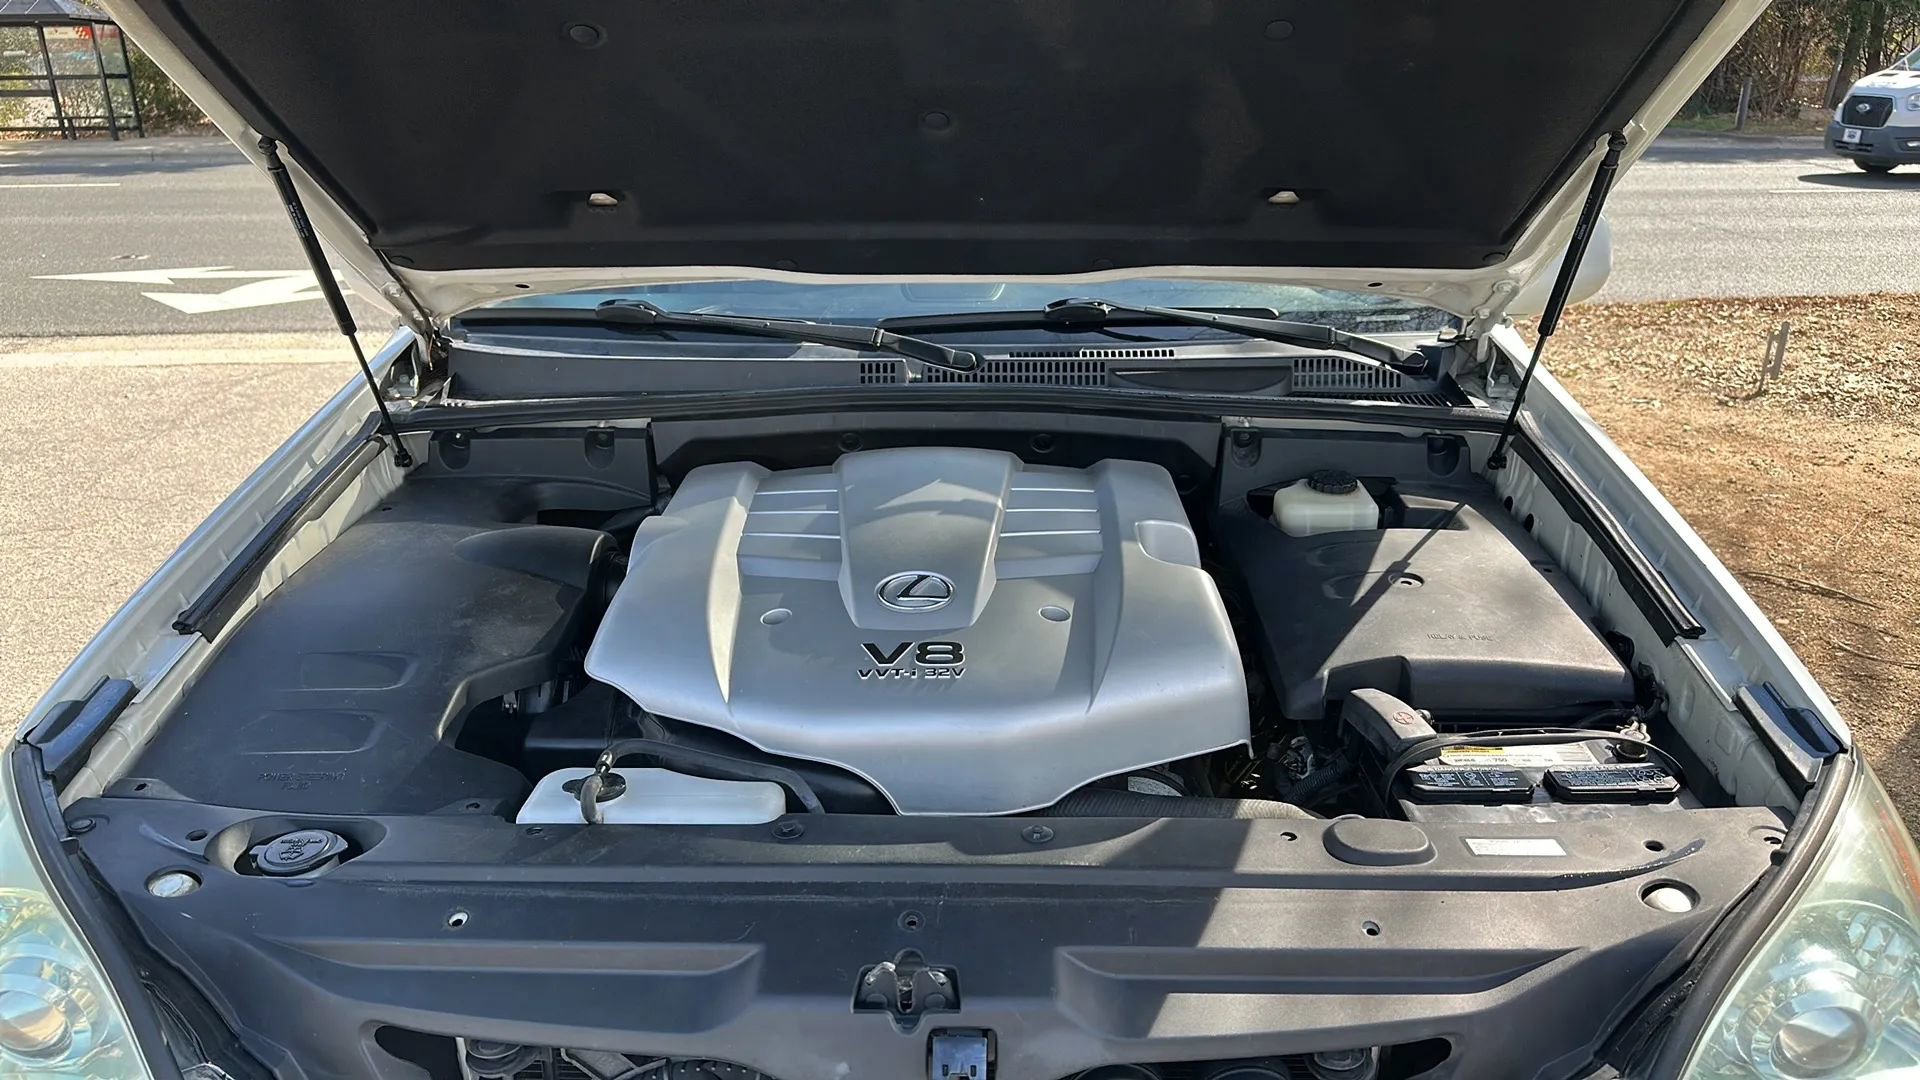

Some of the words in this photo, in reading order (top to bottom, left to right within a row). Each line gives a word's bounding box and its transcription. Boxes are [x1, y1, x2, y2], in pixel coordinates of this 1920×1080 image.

[860, 641, 965, 666] V8
[857, 668, 917, 679] VVT-i
[925, 668, 966, 678] 32V
